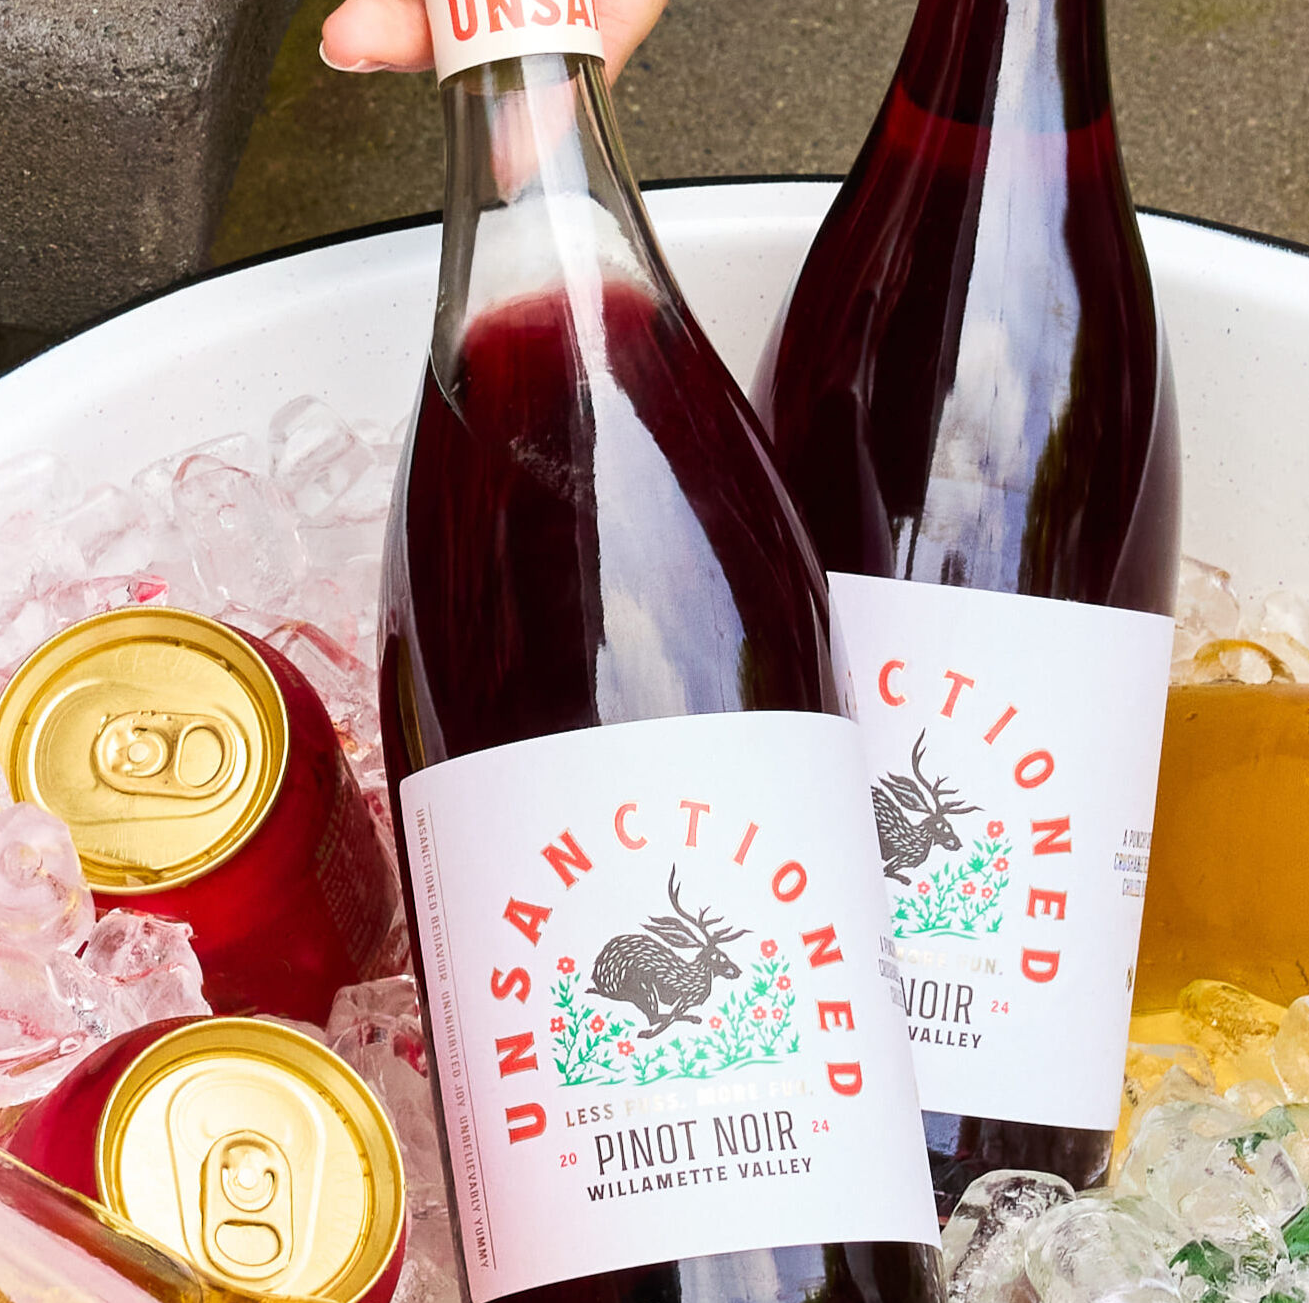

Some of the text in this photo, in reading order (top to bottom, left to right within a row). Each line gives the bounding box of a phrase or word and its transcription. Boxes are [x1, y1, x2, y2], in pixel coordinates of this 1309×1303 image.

[878, 659, 1072, 983] CTIONED
[416, 808, 438, 911] UNSANCTIONED
[430, 916, 448, 982] BEHAVIOR
[490, 800, 863, 1144] UNSANCTIONED
[990, 1000, 1009, 1014] 24
[908, 1025, 982, 1049] VALLEY
[454, 1083, 466, 1107] JOY
[566, 1104, 614, 1128] LESS
[459, 1115, 482, 1213] UNBELIEVABLY
[559, 1110, 830, 1176] 20 PINOT NOIR 24
[587, 1157, 812, 1202] WILLAMETTE VALLEY
[474, 1218, 489, 1269] YUMMY
